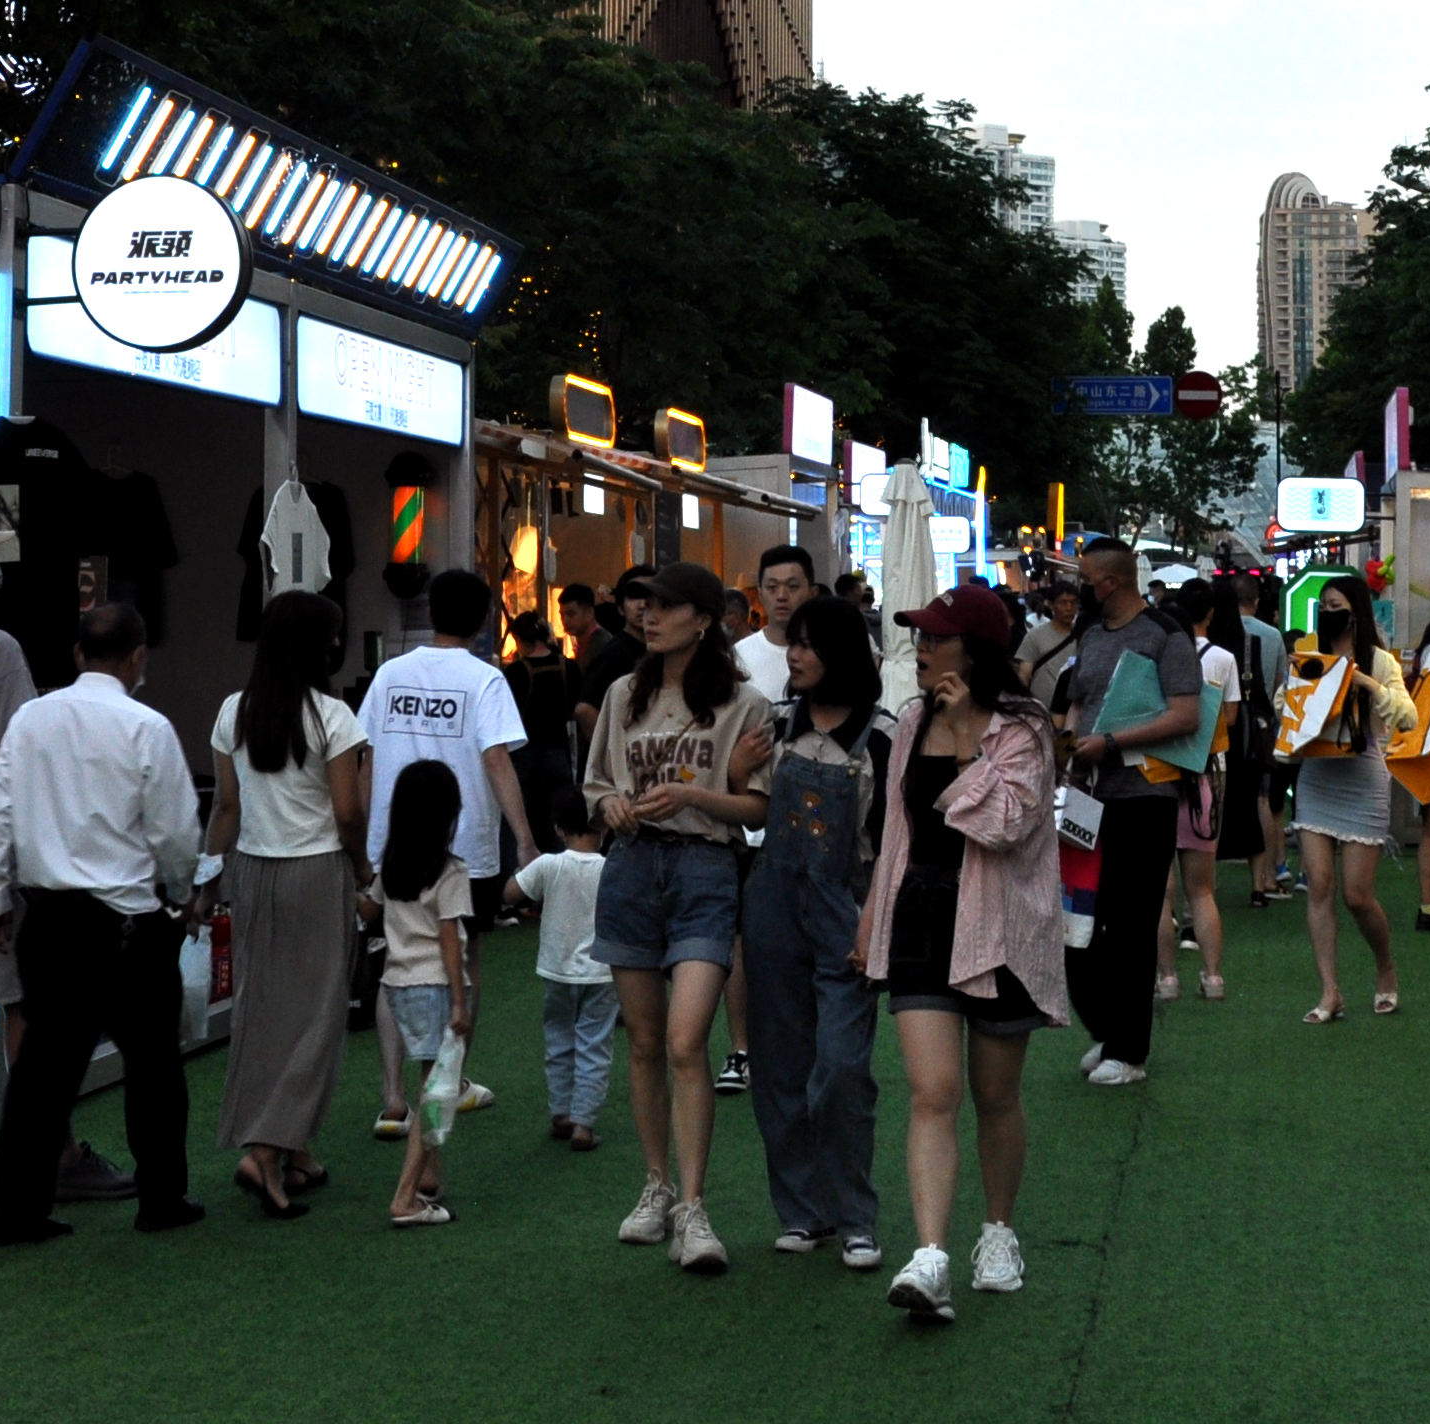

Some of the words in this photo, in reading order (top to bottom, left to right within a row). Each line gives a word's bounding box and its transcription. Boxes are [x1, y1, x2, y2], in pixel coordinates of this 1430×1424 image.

[90, 269, 225, 285] PARTYHEAD
[389, 695, 458, 720] KENZO
[387, 717, 456, 730] PARIS
